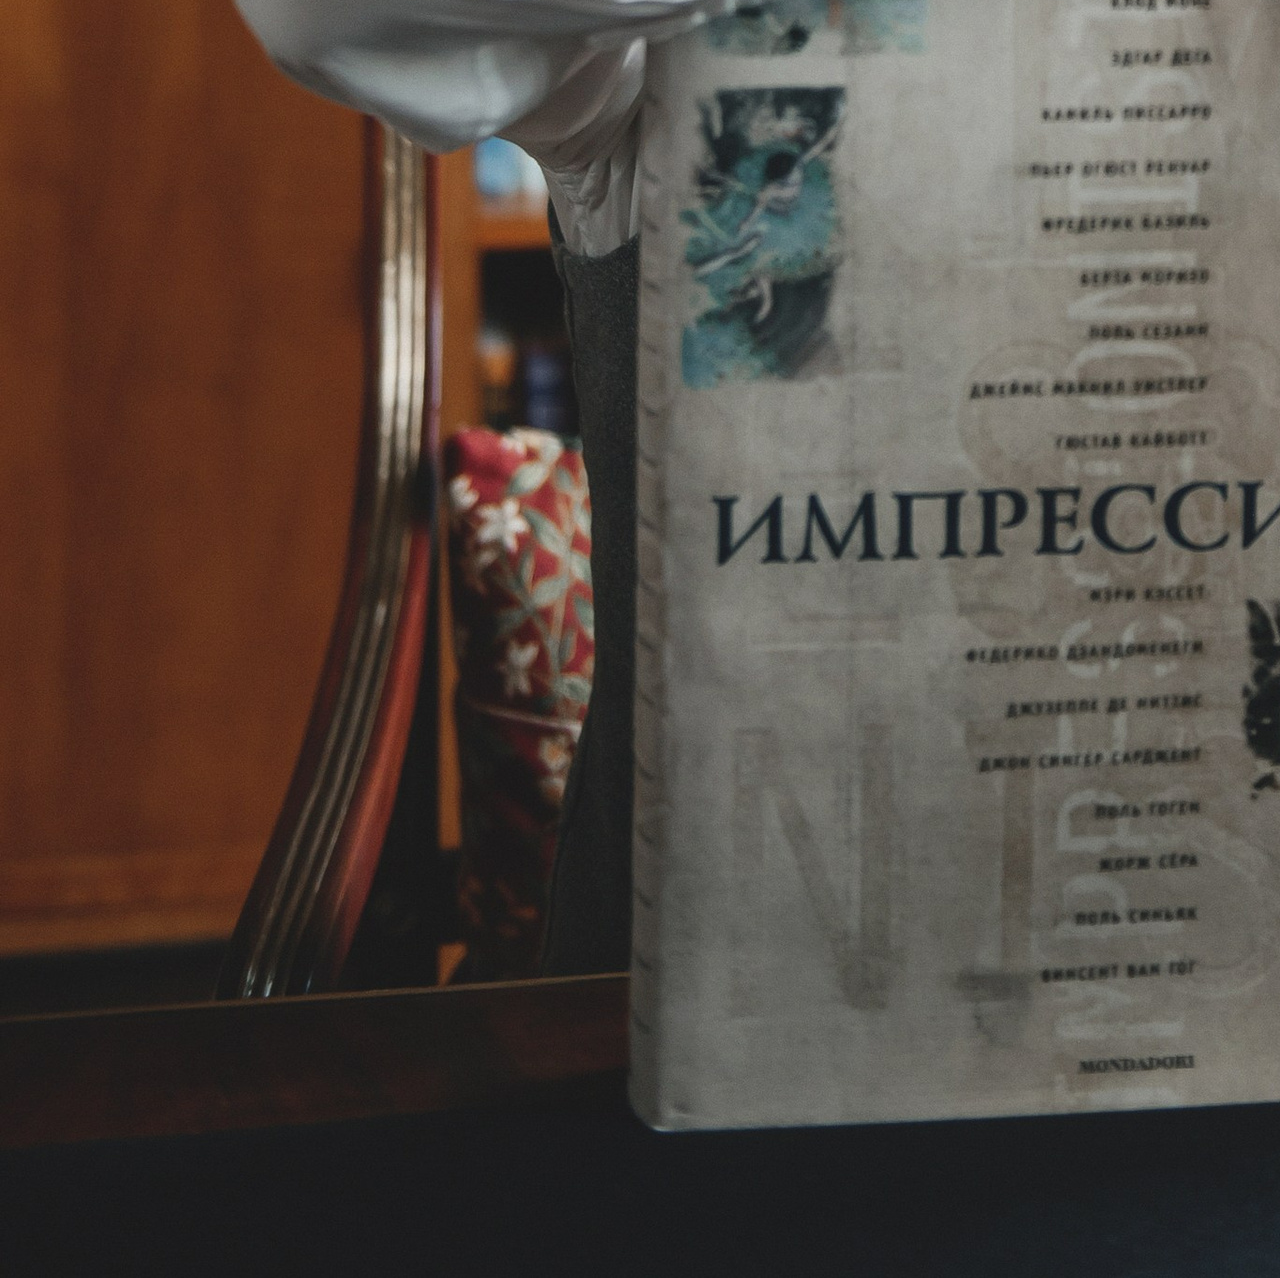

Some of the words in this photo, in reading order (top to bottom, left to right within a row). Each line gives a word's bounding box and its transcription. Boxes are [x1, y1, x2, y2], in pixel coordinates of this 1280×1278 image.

[1112, 50, 1163, 67] ЭДГАР
[1171, 50, 1212, 66] ДЕГА
[1042, 107, 1114, 122] КАМИЛЬ
[1123, 105, 1212, 121] ПИССАРРО
[1029, 161, 1074, 177] ПЬЕР
[1146, 159, 1211, 176] РЕНУАР
[1042, 216, 1133, 233] ФРЕДЕРИК
[1142, 215, 1210, 229] БАЗИЛЬ
[1141, 268, 1210, 284] МОРИЗО
[1088, 325, 1135, 340] ПОЛЬ
[1142, 322, 1209, 338] СЕЗАНН
[969, 380, 1045, 399] ДЖЕЙМС
[1133, 376, 1208, 393] УИСТЛЕР
[1055, 432, 1121, 449] ГЮСТАВ
[1130, 429, 1209, 447] КАЙБОТТ
[1089, 587, 1136, 603] МЭРИ
[1144, 584, 1206, 601] КЭССЕТ
[965, 646, 1059, 663] ФЕДЕРИКО
[1006, 700, 1099, 718] ДЖУЗЕППЕ
[1107, 698, 1127, 714] ДЕ
[978, 755, 1031, 773] ДЖОН
[1038, 751, 1103, 769] СИНГЕР
[1110, 746, 1202, 766] САРДЖЕНТ
[1094, 803, 1141, 819] ПОЛЬ
[1148, 800, 1201, 815] ГОГЕН
[1098, 854, 1151, 871] ЖОРЖ
[1074, 910, 1120, 925] ПОЛЬ
[1128, 906, 1198, 923] СИНЬЯК
[1040, 964, 1119, 983] ВИНСЕНТ
[1126, 962, 1161, 978] ВАН
[1168, 960, 1197, 974] ГОГ
[1078, 1054, 1195, 1073] MONDADORI
